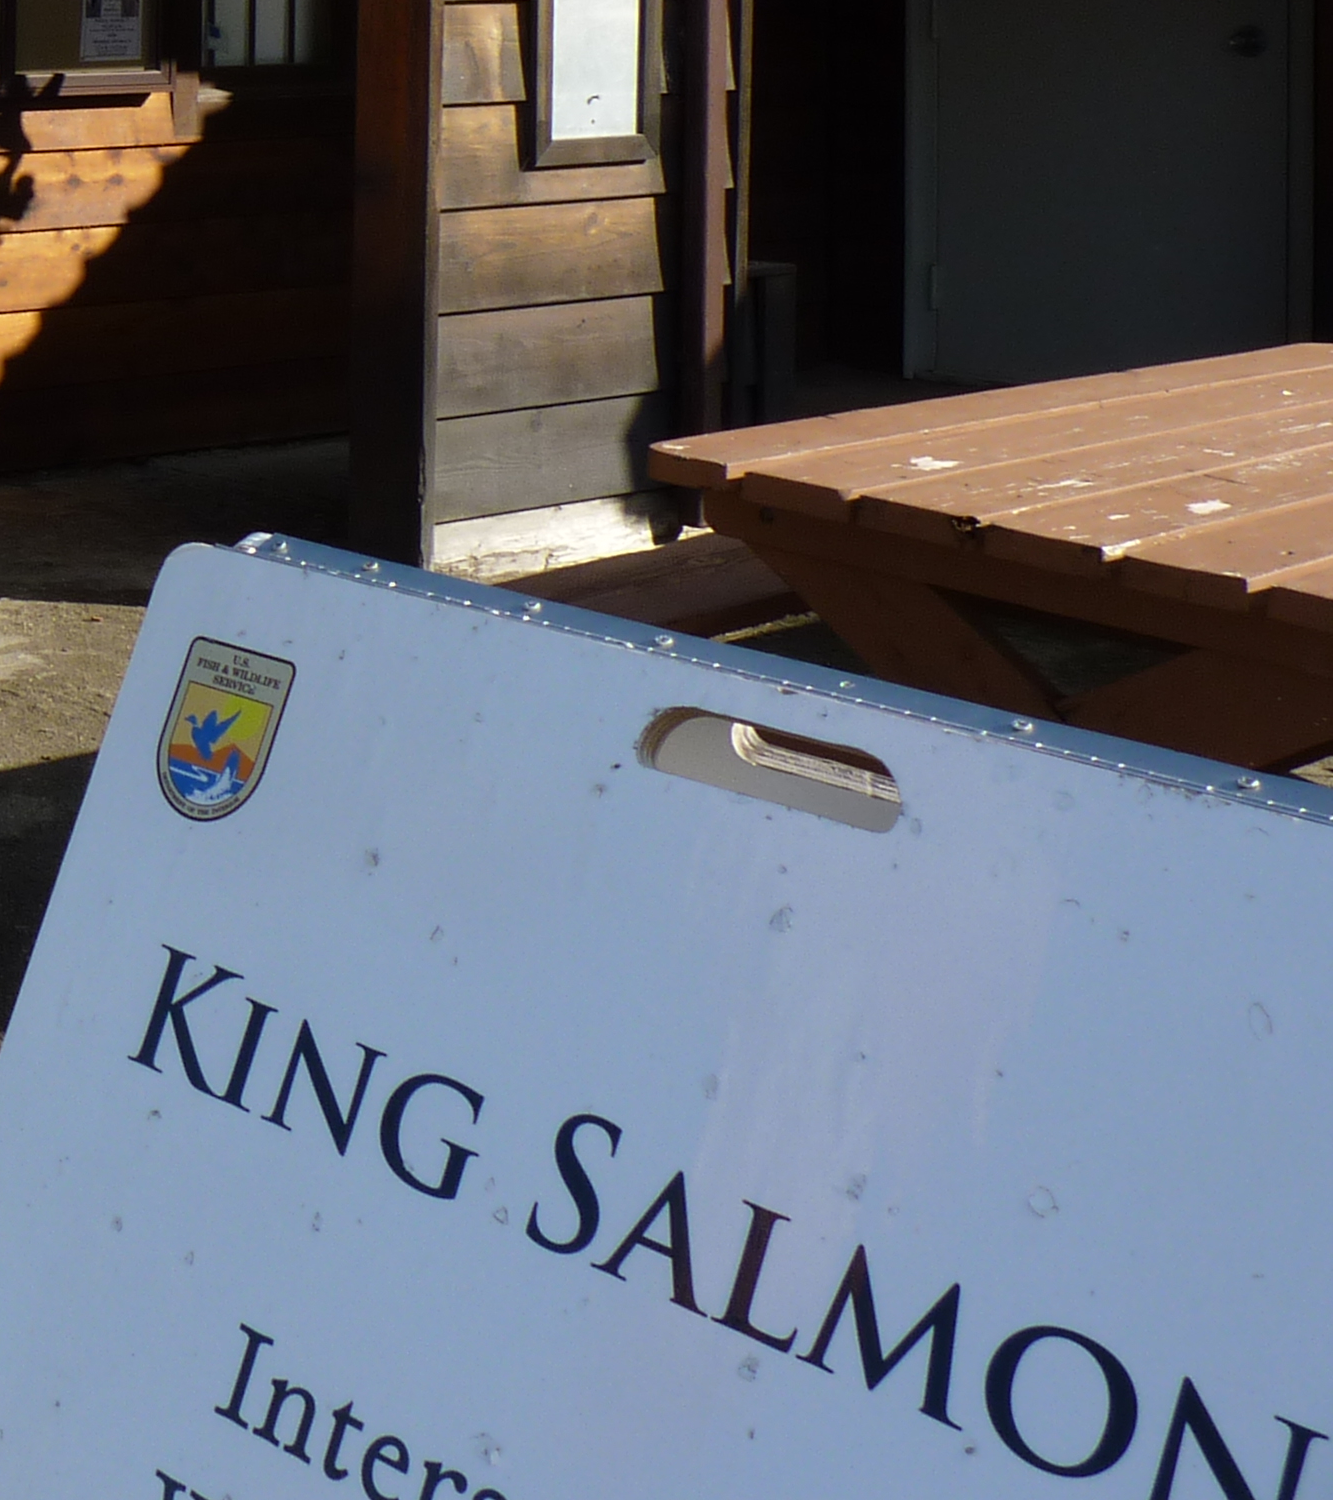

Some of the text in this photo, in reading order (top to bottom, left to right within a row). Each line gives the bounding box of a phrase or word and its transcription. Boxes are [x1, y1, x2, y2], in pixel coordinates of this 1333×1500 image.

[197, 657, 281, 690] FISH & WILDLIFE
[126, 944, 1330, 1500] KING SALMON
[213, 1322, 510, 1500] Inter
